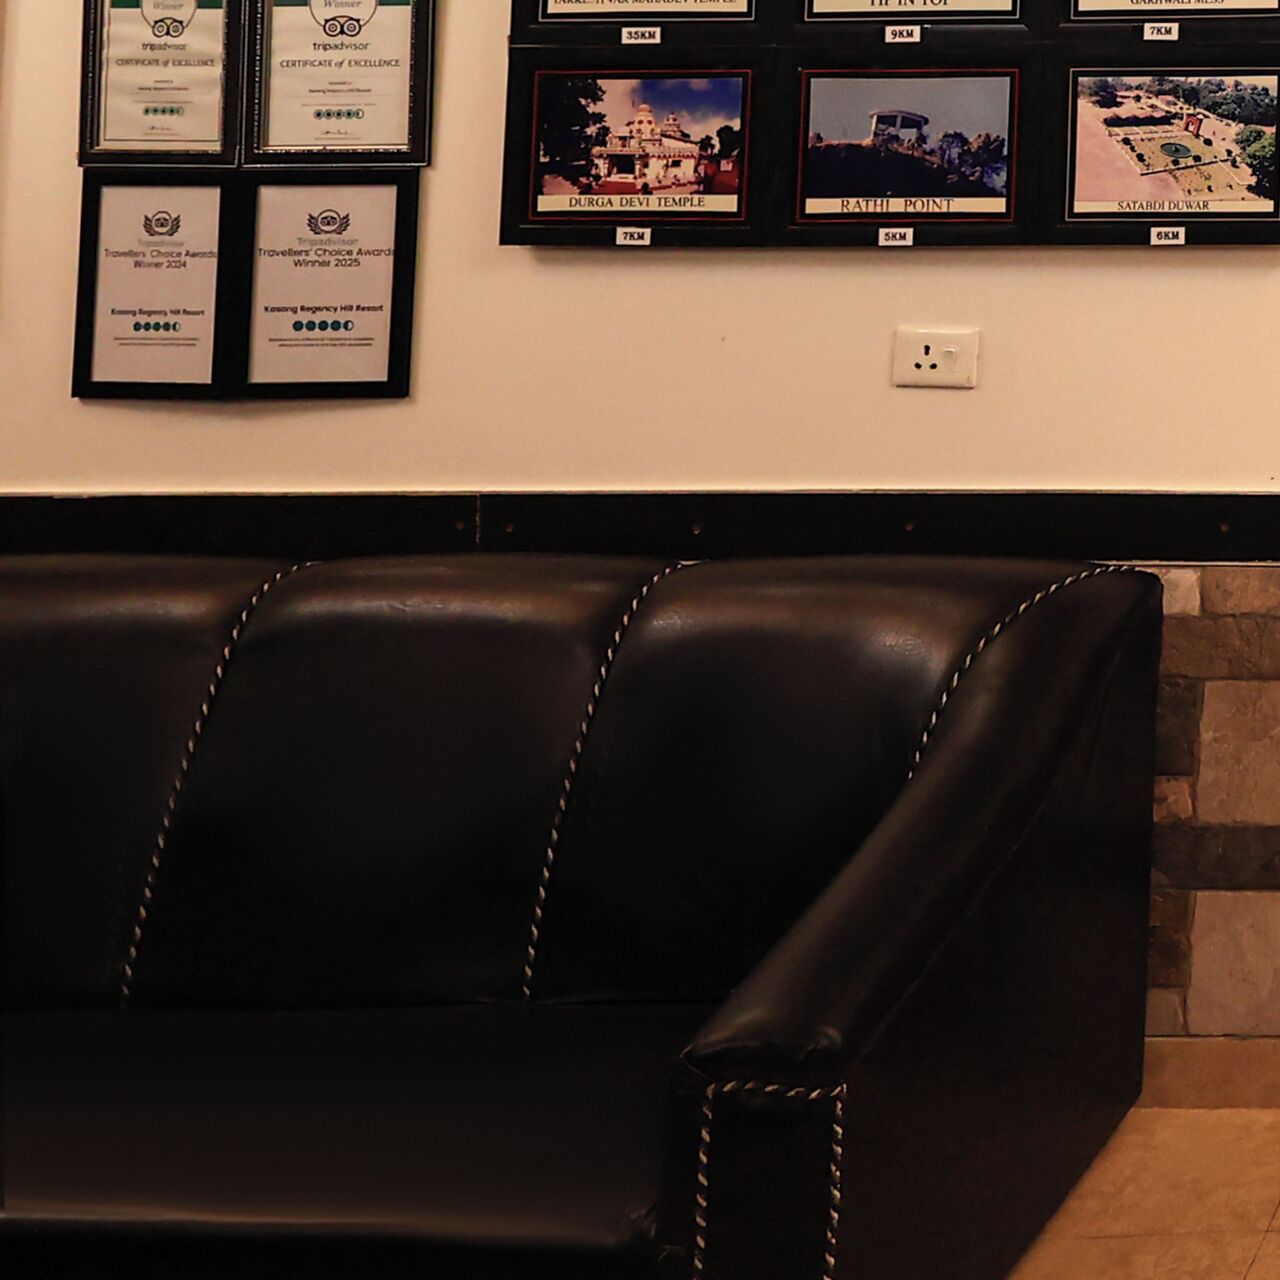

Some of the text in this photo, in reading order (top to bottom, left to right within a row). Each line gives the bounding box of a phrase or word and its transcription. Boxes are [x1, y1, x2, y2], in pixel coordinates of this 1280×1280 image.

[323, 0, 362, 8] Winner
[626, 31, 656, 40] 35KM
[891, 29, 914, 39] 9KM
[1150, 26, 1172, 36] 7KM
[312, 41, 370, 51] tripadvisor
[161, 59, 169, 67] of
[280, 59, 400, 69] CERTIFICATE of EXCELLENCE
[569, 196, 705, 208] DURGA DEVI TEMPLE
[841, 199, 953, 213] RATHI POINT
[1118, 201, 1210, 210] SATABDI DUWAR
[623, 231, 645, 241] 7KM
[884, 232, 907, 241] 5KM
[1156, 231, 1179, 240] 6KM
[150, 249, 182, 258] Choice
[314, 248, 353, 257] Choice
[166, 260, 187, 269] 2024
[293, 258, 361, 267] Winner 2025
[264, 305, 298, 314] Kasang
[300, 305, 338, 314] Regency
